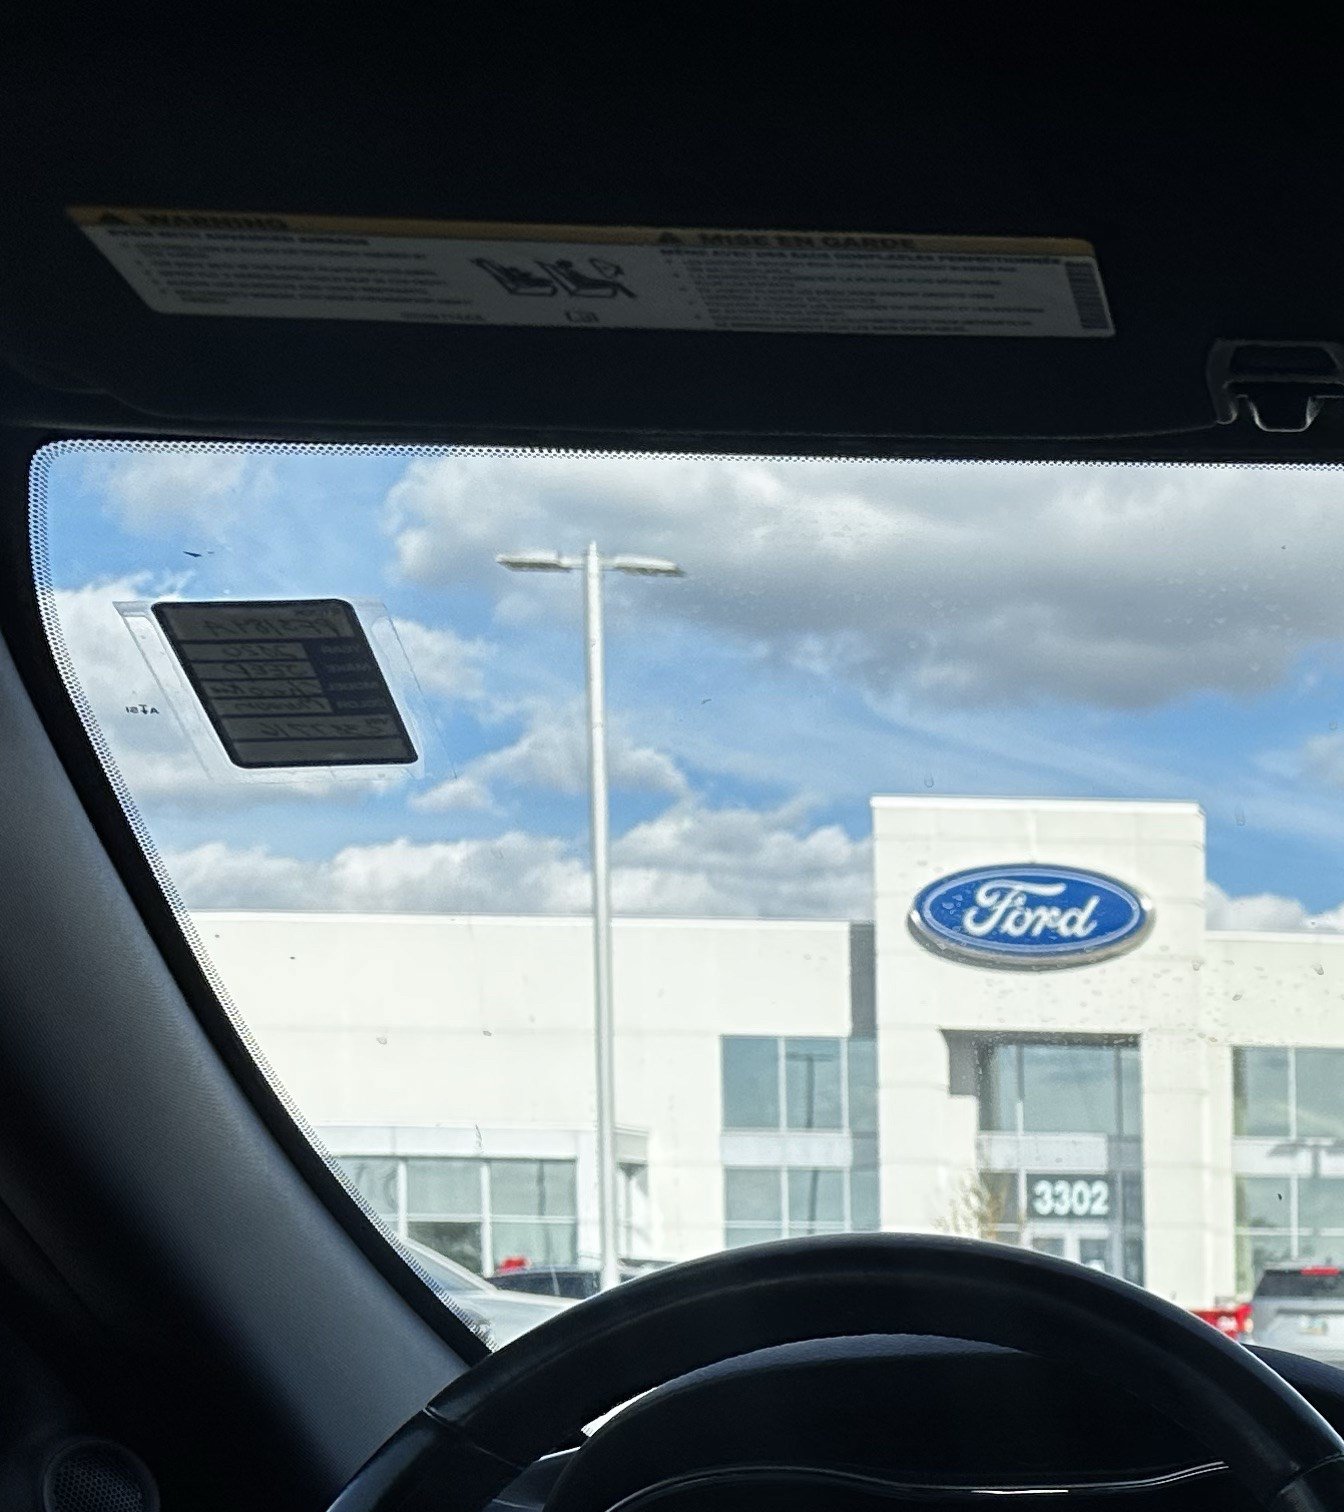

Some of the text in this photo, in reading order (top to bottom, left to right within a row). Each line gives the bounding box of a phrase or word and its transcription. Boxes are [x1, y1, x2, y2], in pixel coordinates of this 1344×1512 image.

[699, 233, 915, 249] MISE EN GARDE
[963, 879, 1100, 938] Ford
[1033, 1180, 1109, 1216] 3302
